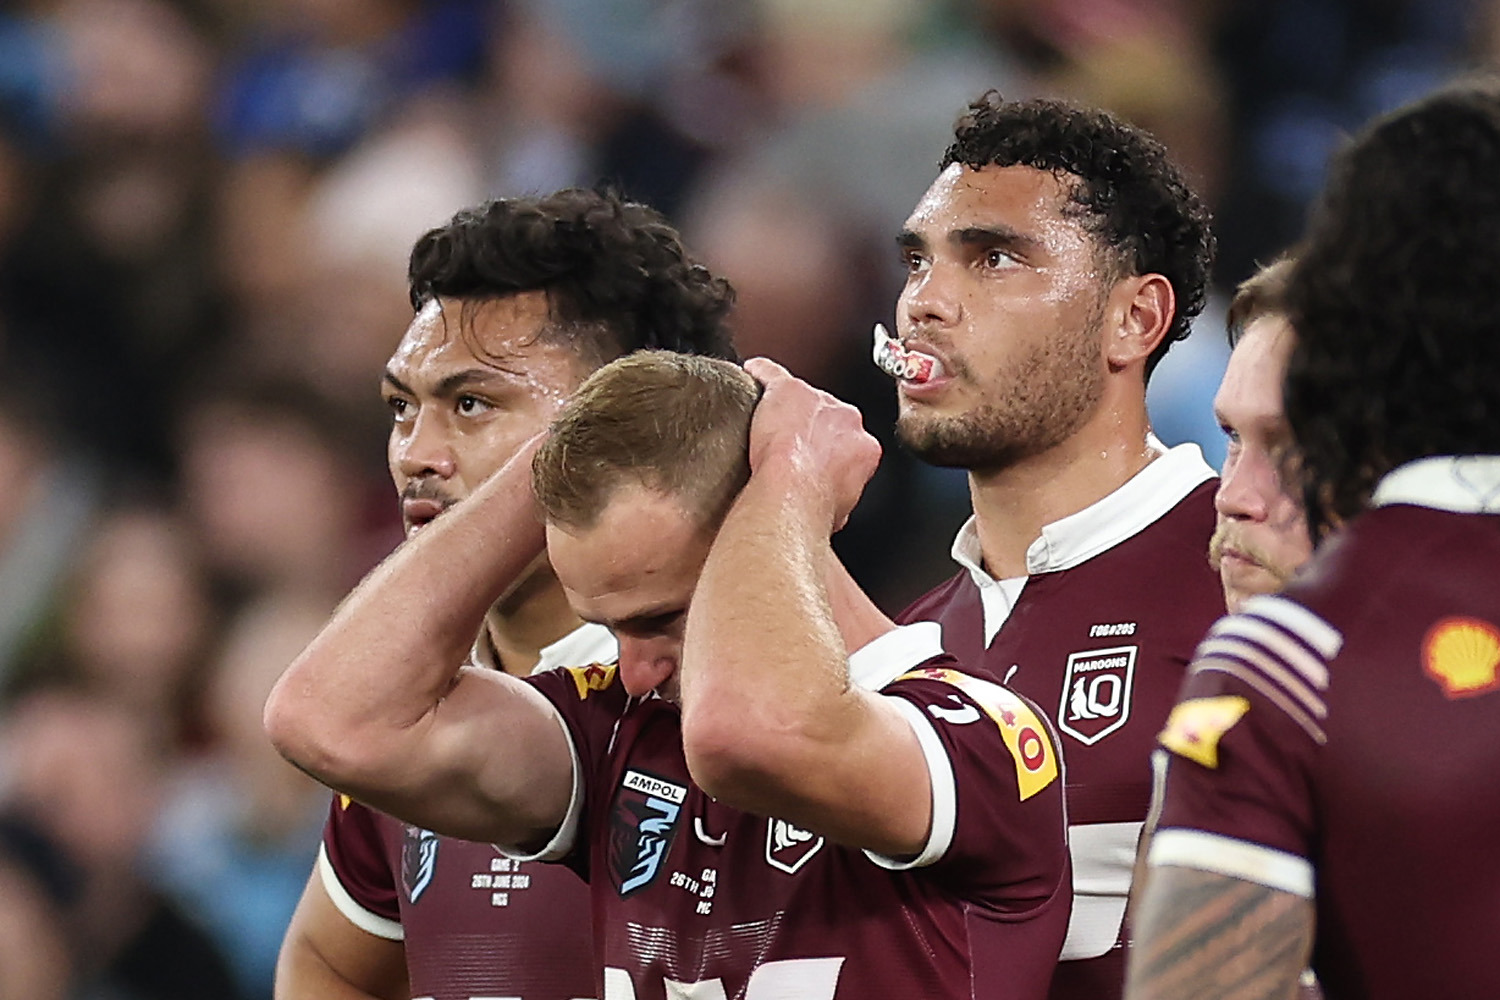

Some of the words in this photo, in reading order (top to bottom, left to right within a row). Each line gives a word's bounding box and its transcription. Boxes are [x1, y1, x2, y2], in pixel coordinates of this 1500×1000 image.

[1073, 656, 1127, 673] MAROONS
[629, 775, 679, 800] AMPOL
[670, 871, 699, 894] 26TH
